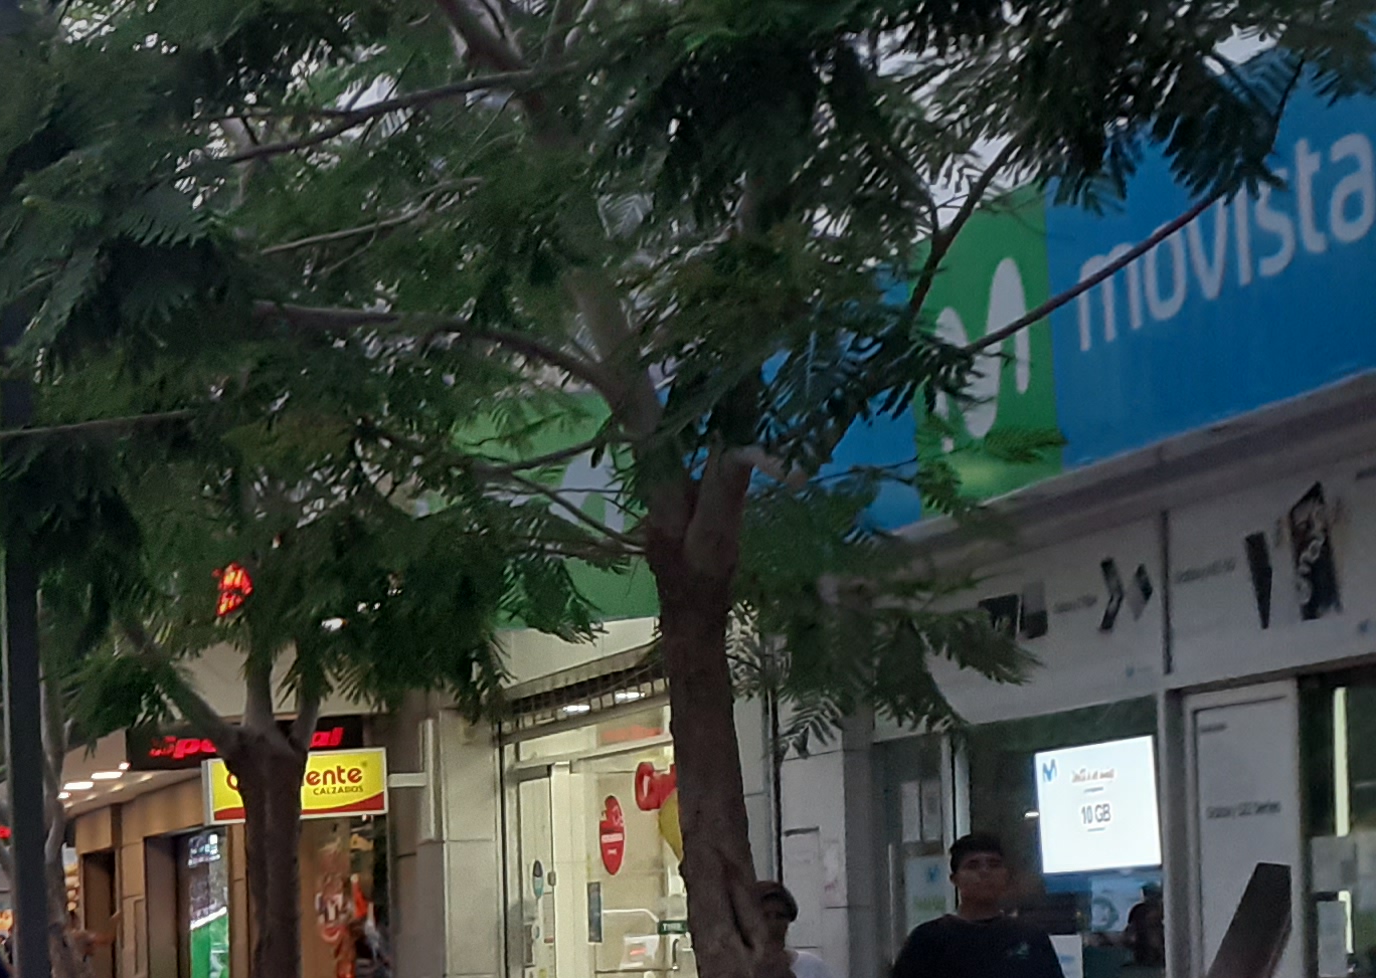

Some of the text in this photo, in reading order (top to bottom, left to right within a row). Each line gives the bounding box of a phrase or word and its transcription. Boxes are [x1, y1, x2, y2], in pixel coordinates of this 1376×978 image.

[313, 785, 363, 796] CALZADOS
[1081, 803, 1112, 825] 10 GB
